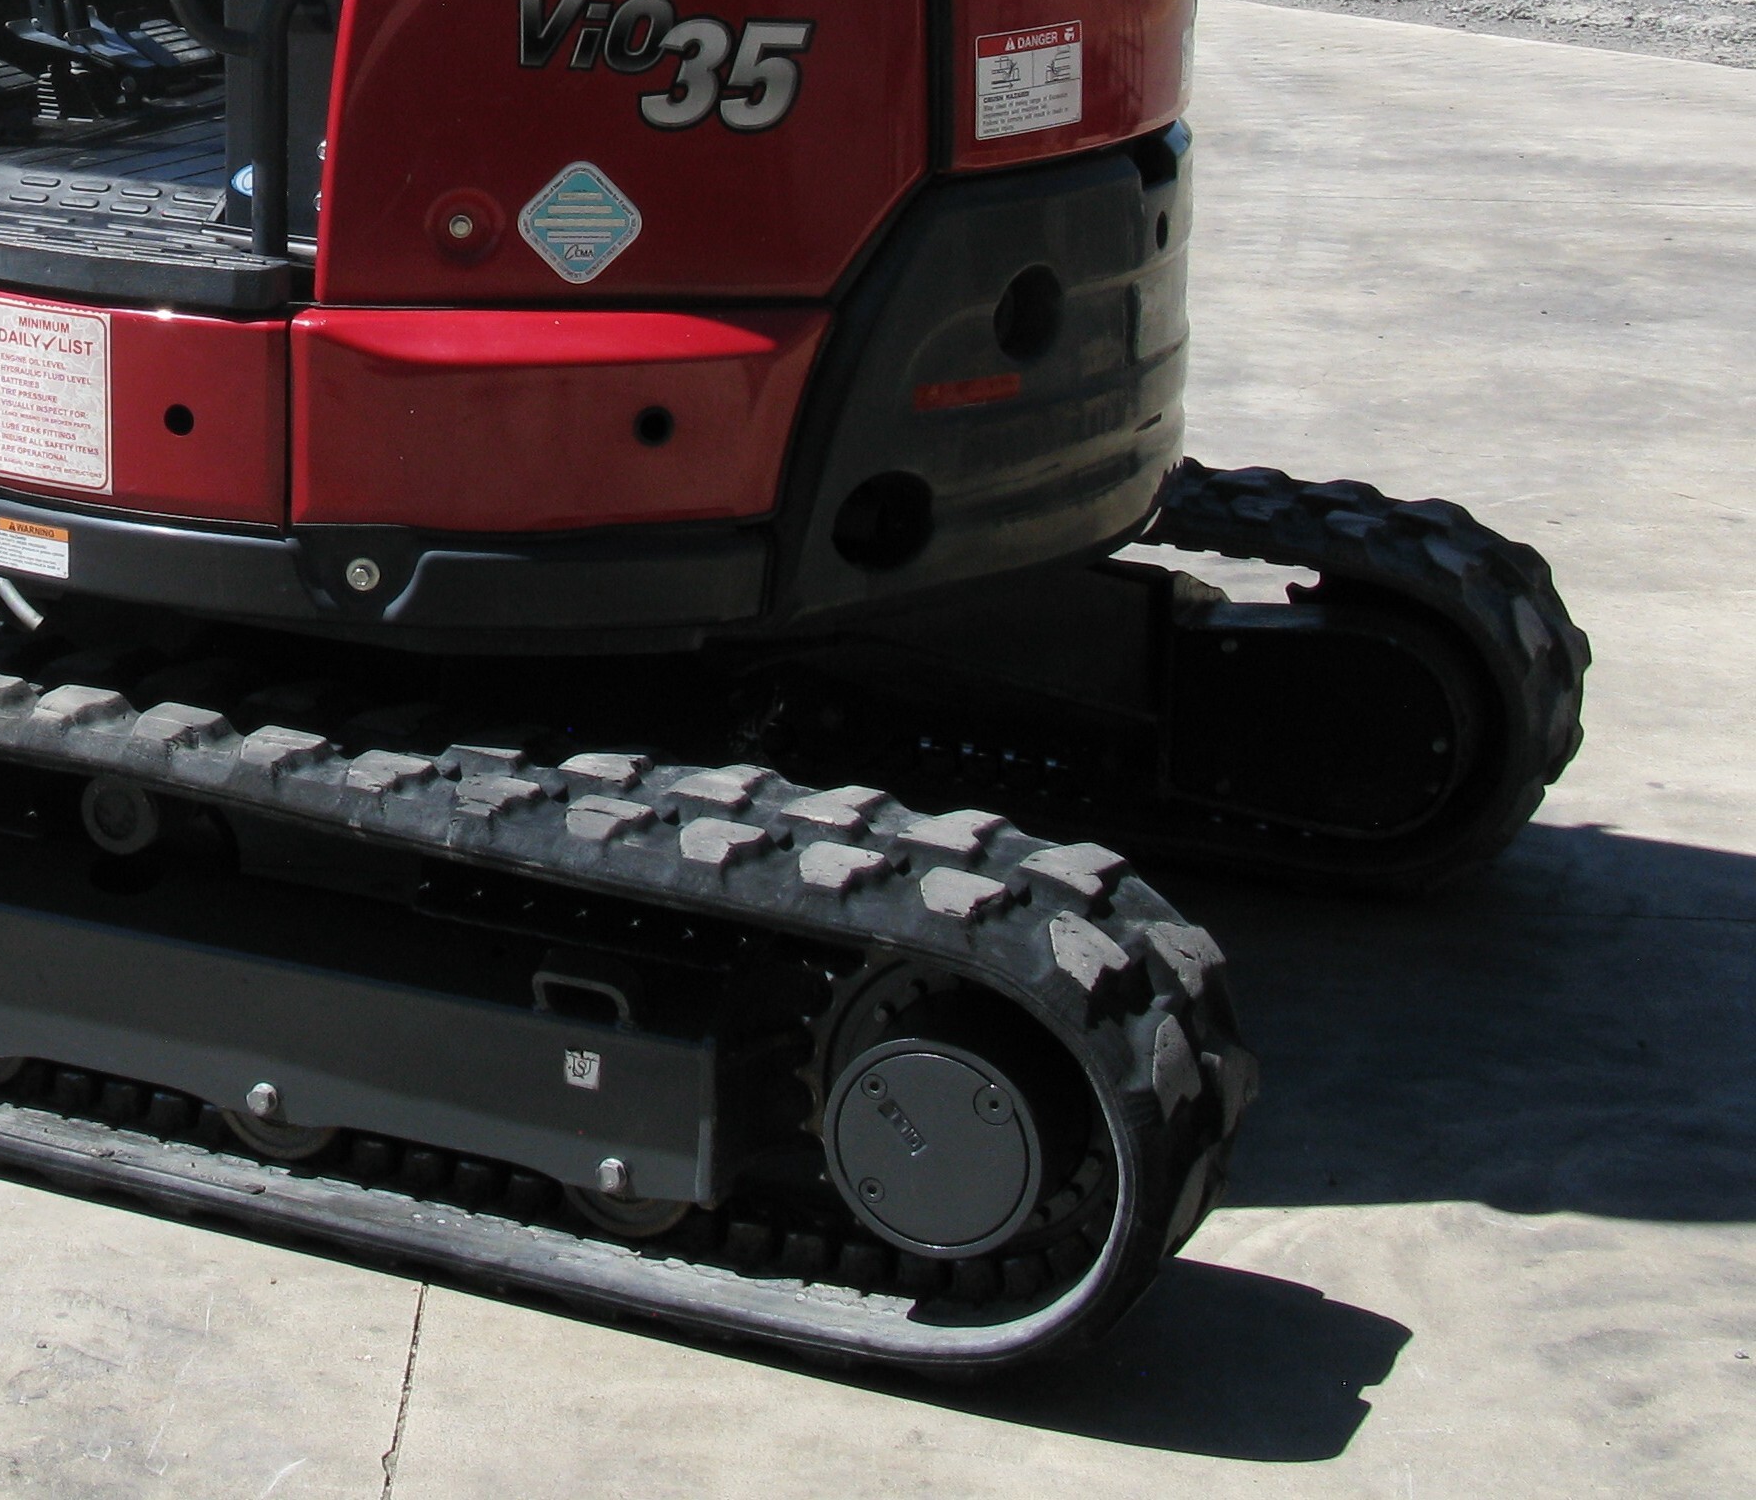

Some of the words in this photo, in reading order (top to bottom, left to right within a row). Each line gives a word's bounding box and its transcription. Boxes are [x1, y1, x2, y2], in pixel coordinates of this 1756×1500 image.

[1017, 31, 1058, 49] DANGER
[18, 315, 70, 334] MINIMUM
[58, 338, 94, 356] LIST
[28, 357, 41, 366] OIL
[42, 360, 68, 371] LEVEL
[0, 364, 42, 378] HYDRAULIC
[43, 372, 65, 381] FLUID
[66, 376, 92, 386] LEVEL
[0, 375, 40, 389] BATTERIES
[1, 386, 17, 396] TIRE
[18, 389, 58, 404] PRESSURE
[1, 398, 35, 411] VISUALLY
[36, 405, 68, 417] INSPECT
[1, 421, 20, 432] LUBE
[42, 428, 77, 441] FITTINGS
[1, 443, 16, 453] ARE
[16, 446, 69, 463] OPERATIONAL
[28, 438, 44, 447] ALL
[44, 440, 74, 452] SAFETY
[75, 445, 100, 456] ITEMS
[15, 523, 55, 538] WARNING
